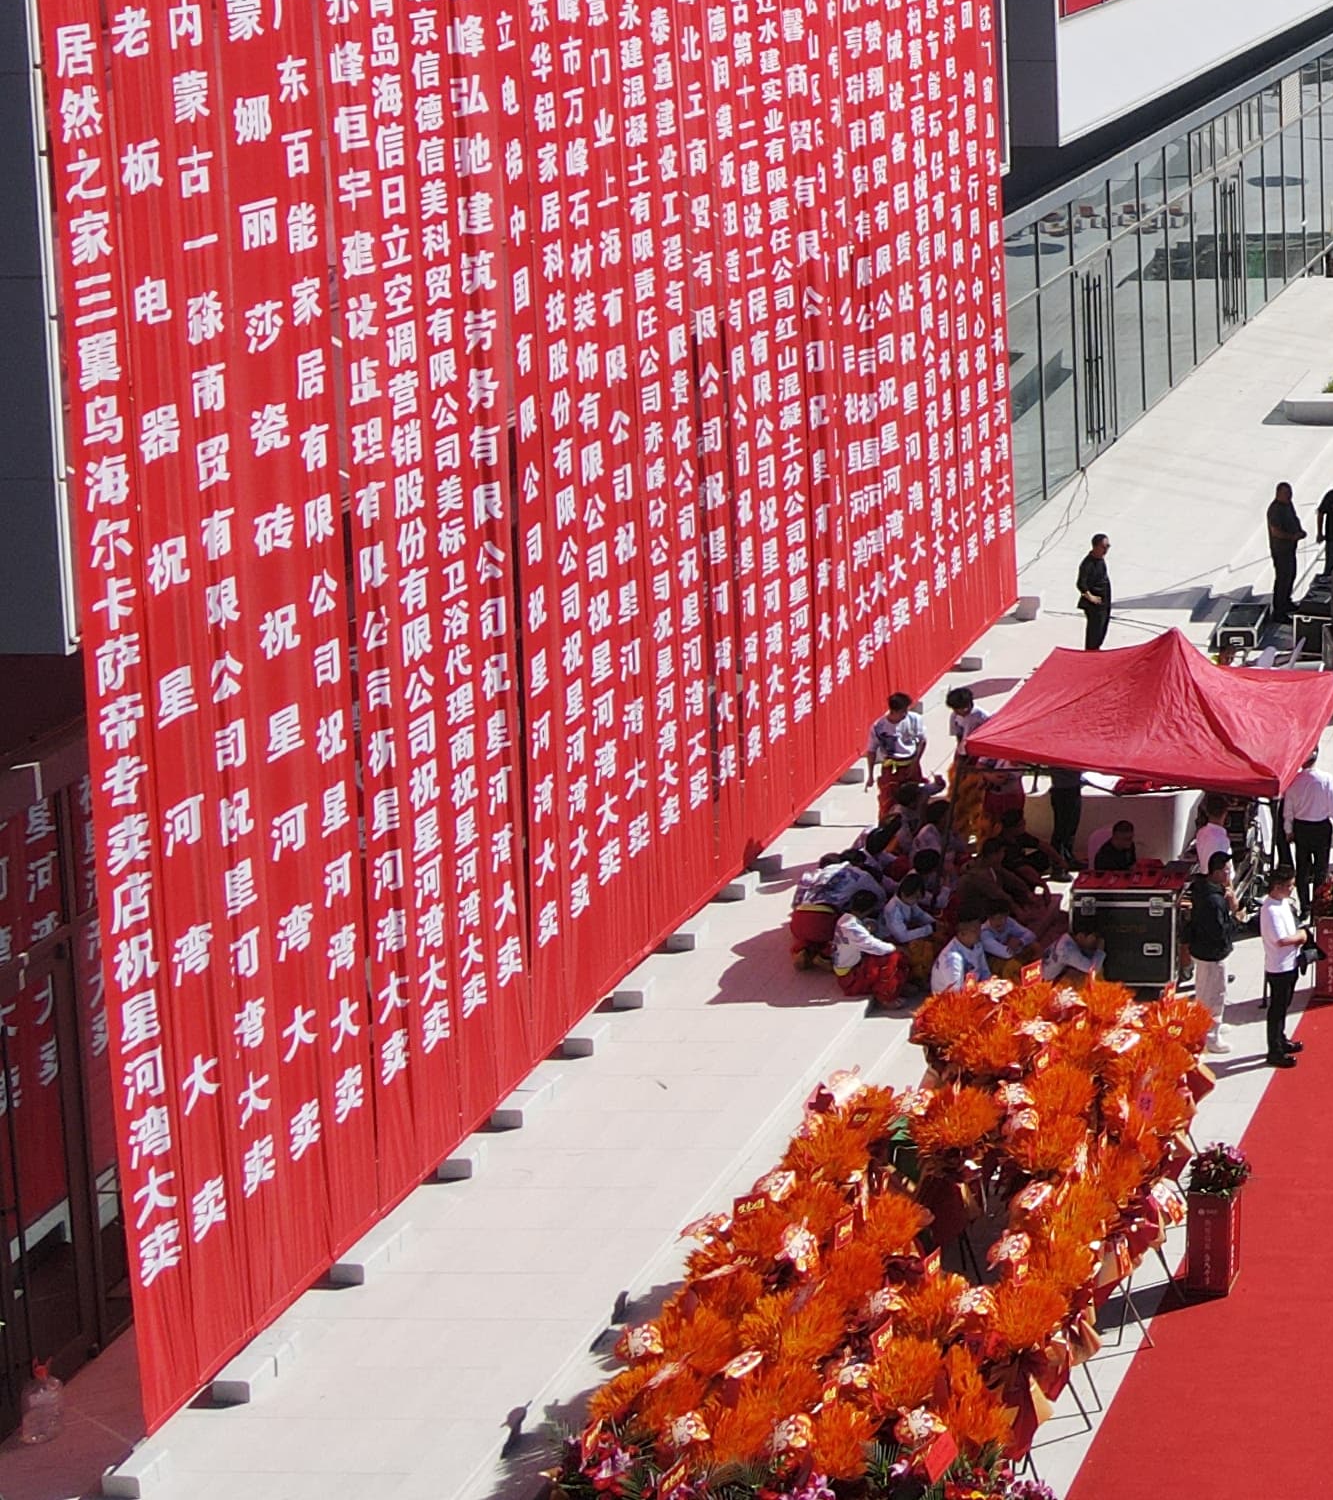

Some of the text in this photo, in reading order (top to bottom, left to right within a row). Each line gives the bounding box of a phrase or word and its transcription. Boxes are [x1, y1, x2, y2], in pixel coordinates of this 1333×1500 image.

[109, 3, 231, 1248] 老板电器祝星河湾大卖
